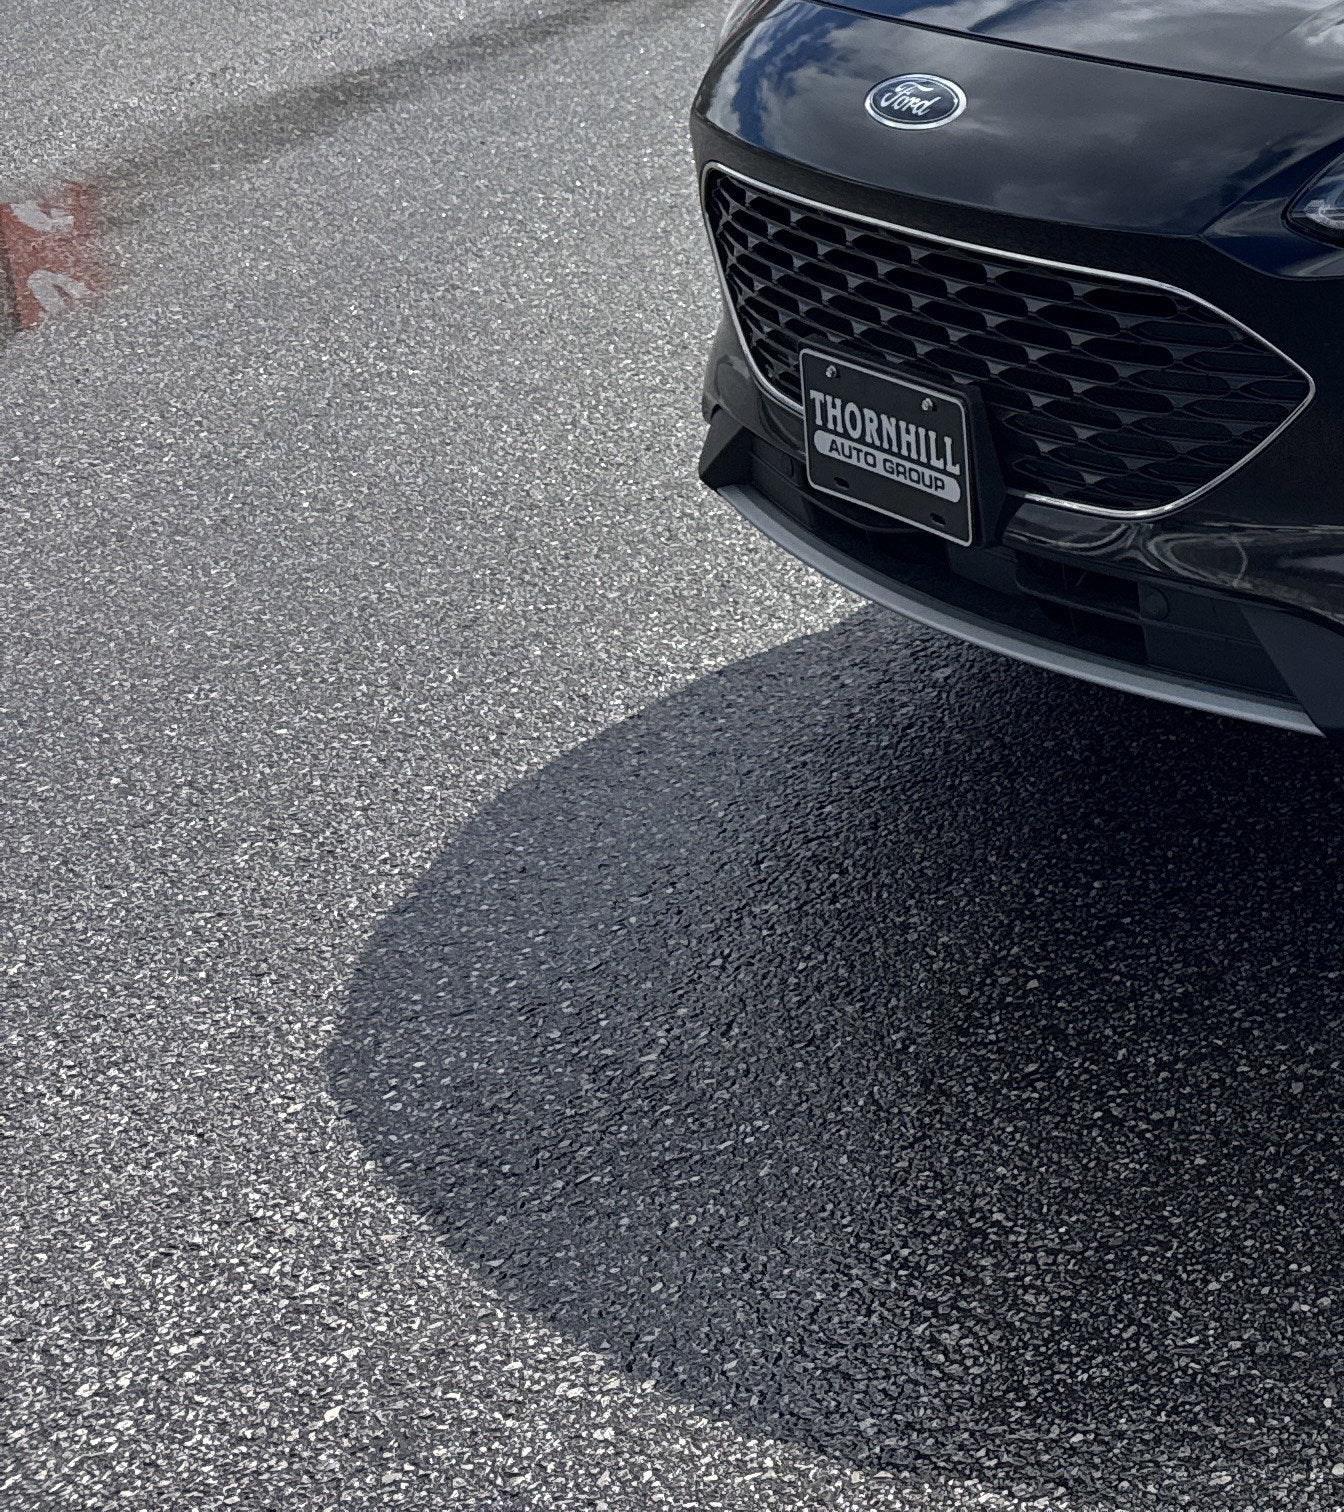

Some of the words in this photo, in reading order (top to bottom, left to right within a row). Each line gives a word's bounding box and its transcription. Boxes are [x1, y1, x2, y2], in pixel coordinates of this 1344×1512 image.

[880, 81, 941, 116] Ford
[809, 389, 961, 476] THORNHILL
[828, 438, 877, 469] AUTO
[883, 457, 946, 492] GROUP
